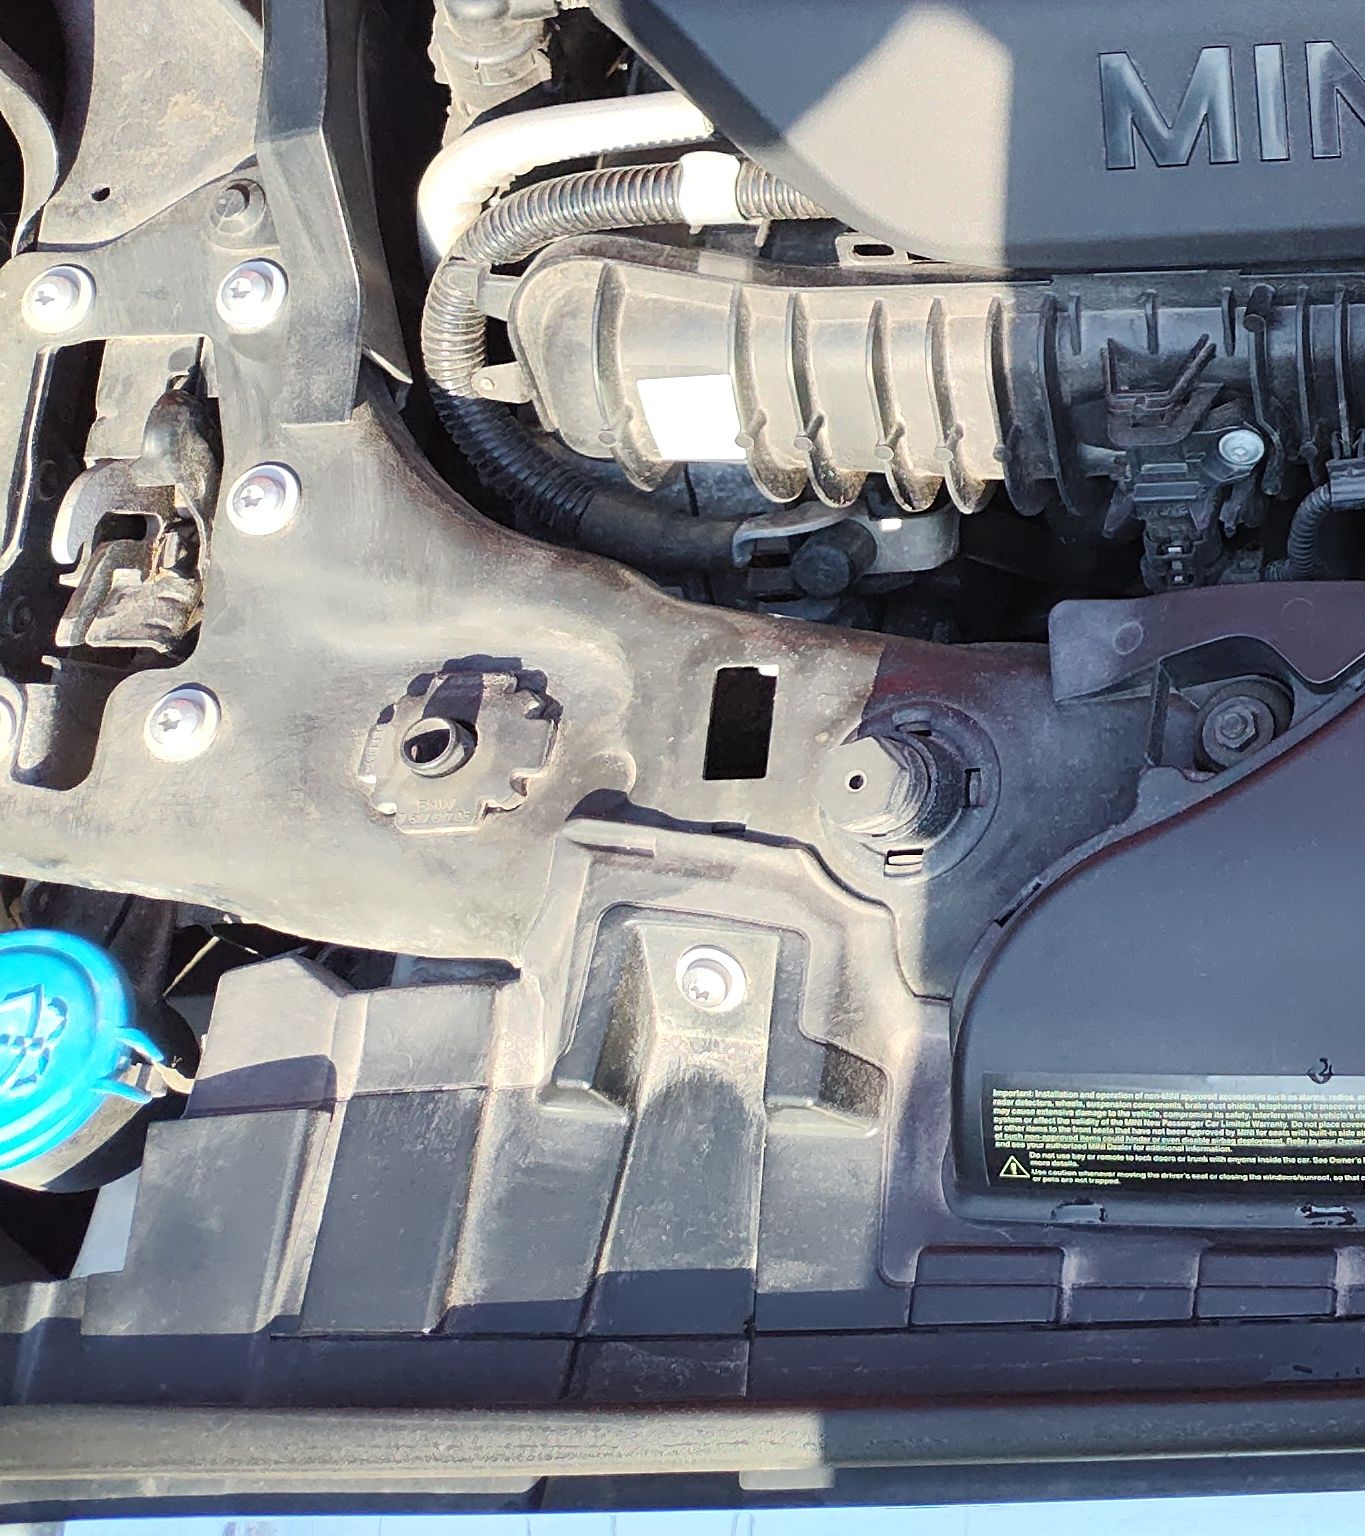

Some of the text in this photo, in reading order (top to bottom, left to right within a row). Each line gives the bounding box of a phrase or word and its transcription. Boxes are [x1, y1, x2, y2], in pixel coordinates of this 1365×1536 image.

[1035, 1090, 1078, 1099] Installation
[1080, 1091, 1094, 1099] and
[1096, 1091, 1133, 1101] operation
[1135, 1092, 1144, 1100] of
[1180, 1093, 1217, 1103] approved
[1299, 1094, 1328, 1103] alarms,
[1329, 1094, 1356, 1103] radios,
[993, 1098, 1014, 1106] radar
[1014, 1098, 1054, 1108] detectors,
[1055, 1099, 1085, 1109] wheels,
[1133, 1101, 1184, 1111] components,
[1185, 1102, 1207, 1110] brake
[1208, 1102, 1226, 1110] dust
[1259, 1102, 1302, 1112] telephones
[1313, 1103, 1356, 1111] transceiver
[993, 1108, 1010, 1116] may
[1036, 1107, 1074, 1116] extensive
[1075, 1108, 1107, 1118] damage
[1108, 1109, 1116, 1117] to
[1117, 1109, 1130, 1117] the
[1131, 1109, 1162, 1118] vehicle,
[1163, 1110, 1212, 1120] compromise
[1225, 1111, 1251, 1120] safety,
[1253, 1111, 1286, 1119] interfere
[1305, 1112, 1318, 1120] the
[1319, 1112, 1354, 1120] vehicle's
[993, 1115, 1022, 1125] system
[1033, 1116, 1056, 1124] affect
[1057, 1116, 1070, 1124] the
[1071, 1117, 1100, 1127] validity
[1101, 1117, 1109, 1125] of
[1110, 1118, 1123, 1126] the
[1144, 1118, 1161, 1126] New
[1162, 1119, 1204, 1129] Passenger
[1205, 1119, 1219, 1127] Car
[1221, 1119, 1250, 1127] Limited
[1252, 1120, 1288, 1129] Warranty.
[1292, 1120, 1303, 1128] Do
[1304, 1120, 1317, 1128] not
[1318, 1120, 1339, 1130] place
[1004, 1123, 1024, 1132] other
[1026, 1124, 1048, 1132] items
[1049, 1124, 1057, 1132] to
[1058, 1125, 1071, 1133] the
[1073, 1125, 1091, 1133] front
[1093, 1125, 1114, 1134] seats
[1115, 1126, 1130, 1134] that
[1132, 1126, 1151, 1134] have
[1152, 1127, 1165, 1135] not
[1166, 1127, 1186, 1135] been
[1187, 1127, 1224, 1137] approved
[1226, 1128, 1235, 1137] by
[1256, 1128, 1267, 1136] for
[1268, 1128, 1290, 1136] seats
[1291, 1128, 1308, 1136] with
[1339, 1129, 1355, 1137] side
[995, 1132, 1003, 1140] of
[1004, 1132, 1023, 1141] such
[1025, 1132, 1078, 1143] non-approved
[1080, 1133, 1102, 1143] items
[1103, 1134, 1124, 1143] could
[1125, 1134, 1150, 1144] hinder
[1152, 1136, 1160, 1144] or
[1181, 1136, 1210, 1145] disable
[1211, 1136, 1236, 1146] airbag
[1237, 1136, 1285, 1146] deployment.
[1287, 1137, 1308, 1146] Refer
[1309, 1137, 1317, 1146] to
[1318, 1138, 1336, 1146] your
[995, 1140, 1010, 1148] and
[1026, 1142, 1044, 1150] your
[1045, 1141, 1087, 1150] authorized
[1107, 1143, 1132, 1151] Dealer
[1133, 1143, 1144, 1151] for
[1146, 1143, 1184, 1152] additional
[1185, 1144, 1232, 1152] information.
[1042, 1152, 1055, 1160] not
[1072, 1153, 1085, 1162] key
[1097, 1153, 1124, 1161] remote
[1135, 1154, 1152, 1162] lock
[1153, 1154, 1176, 1162] doors
[1209, 1155, 1226, 1163] with
[1227, 1157, 1256, 1165] anyone
[1313, 1156, 1328, 1164] See
[1329, 1156, 1362, 1164] Owner's
[1042, 1175, 1060, 1184] pets
[1089, 1176, 1121, 1185] trapped.
[1048, 1168, 1077, 1176] caution
[1078, 1169, 1115, 1177] whenever
[1117, 1170, 1146, 1180] moving
[1147, 1171, 1160, 1179] the
[1219, 1173, 1248, 1181] closing
